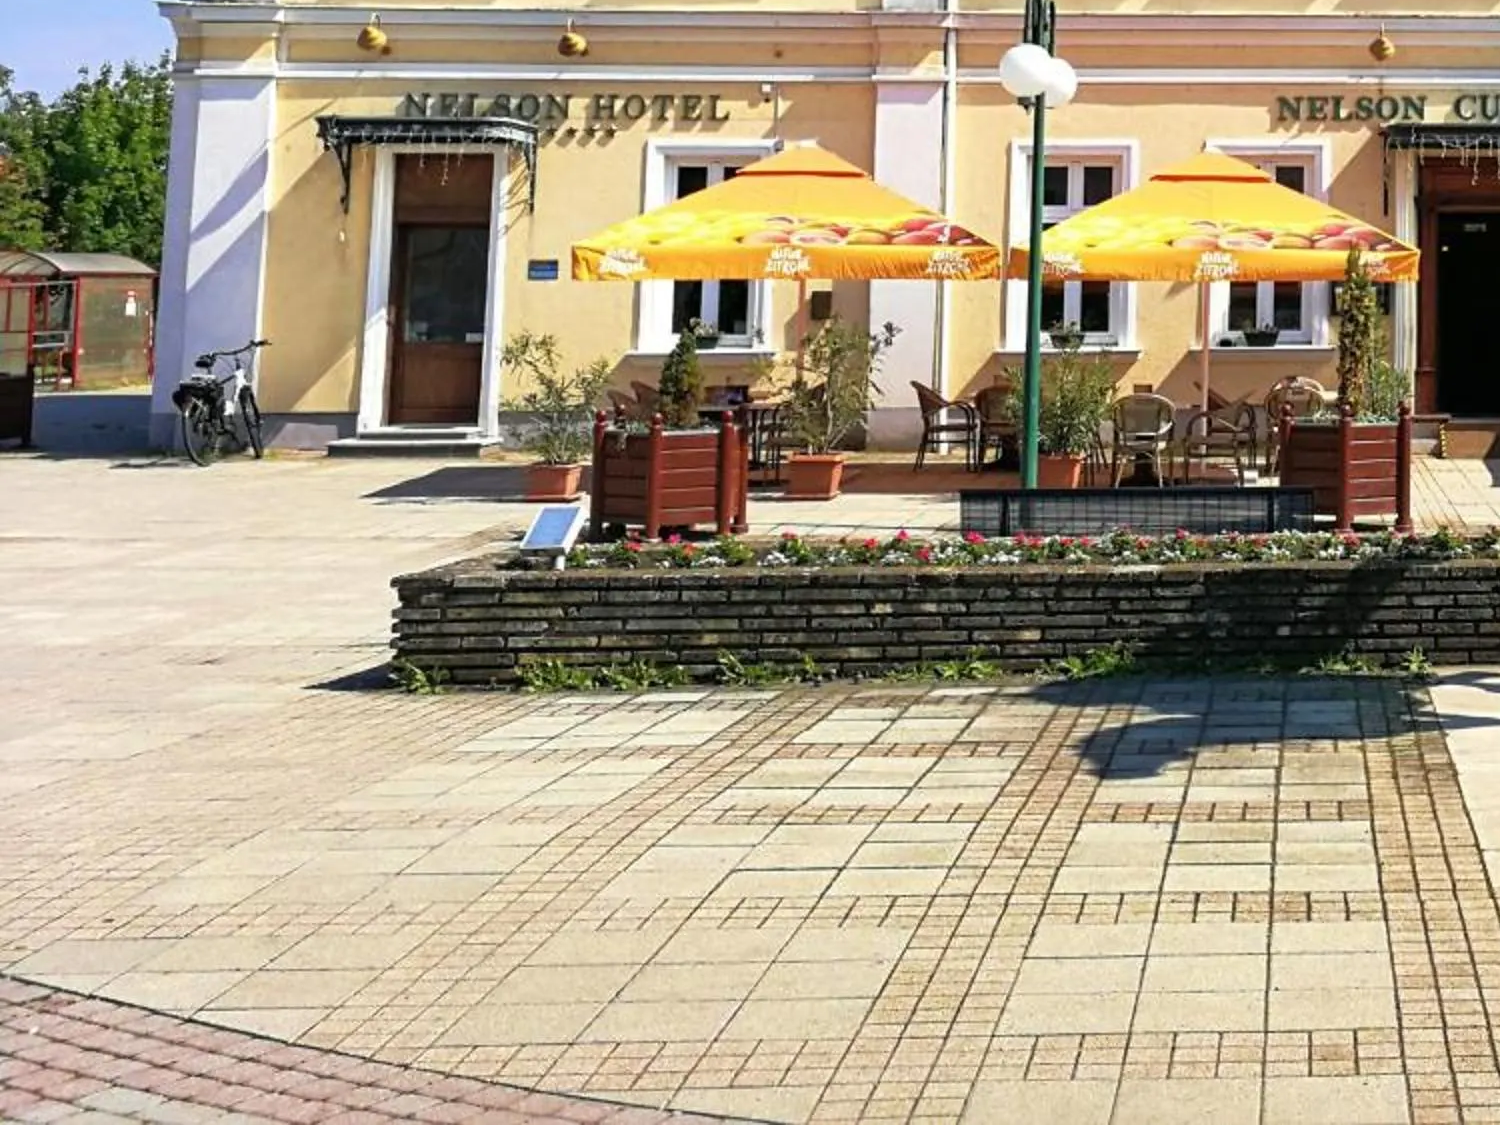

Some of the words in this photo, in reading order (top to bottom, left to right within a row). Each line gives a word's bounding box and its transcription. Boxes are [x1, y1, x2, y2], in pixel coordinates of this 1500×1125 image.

[404, 92, 575, 121] NELSON
[590, 93, 730, 122] HOTEL
[1277, 94, 1428, 122] NELSON
